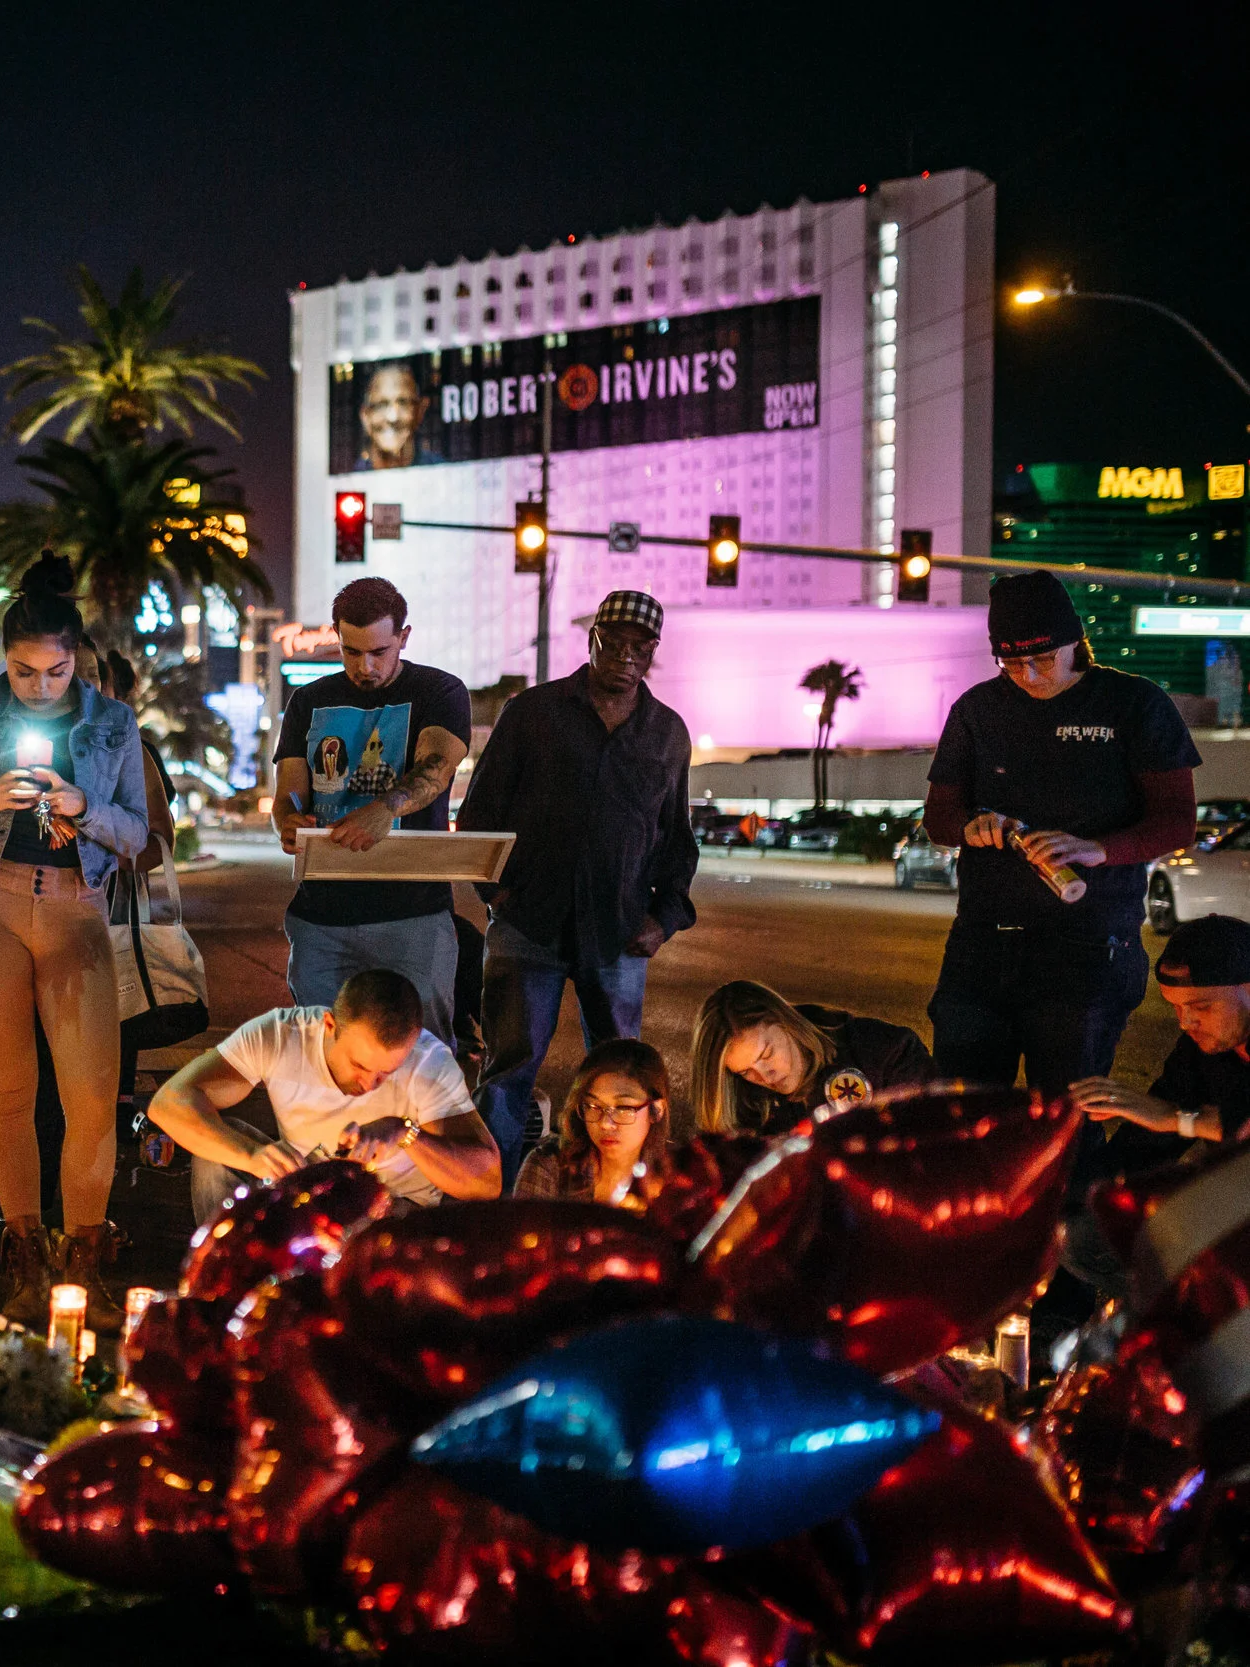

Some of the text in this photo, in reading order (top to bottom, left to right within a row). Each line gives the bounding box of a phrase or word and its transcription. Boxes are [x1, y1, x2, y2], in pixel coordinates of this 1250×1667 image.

[600, 348, 736, 404] IRVINE'S
[765, 382, 816, 409] NOW
[765, 406, 815, 428] OPEN
[1098, 467, 1184, 499] MGM
[1056, 726, 1115, 739] EMS WEEK
